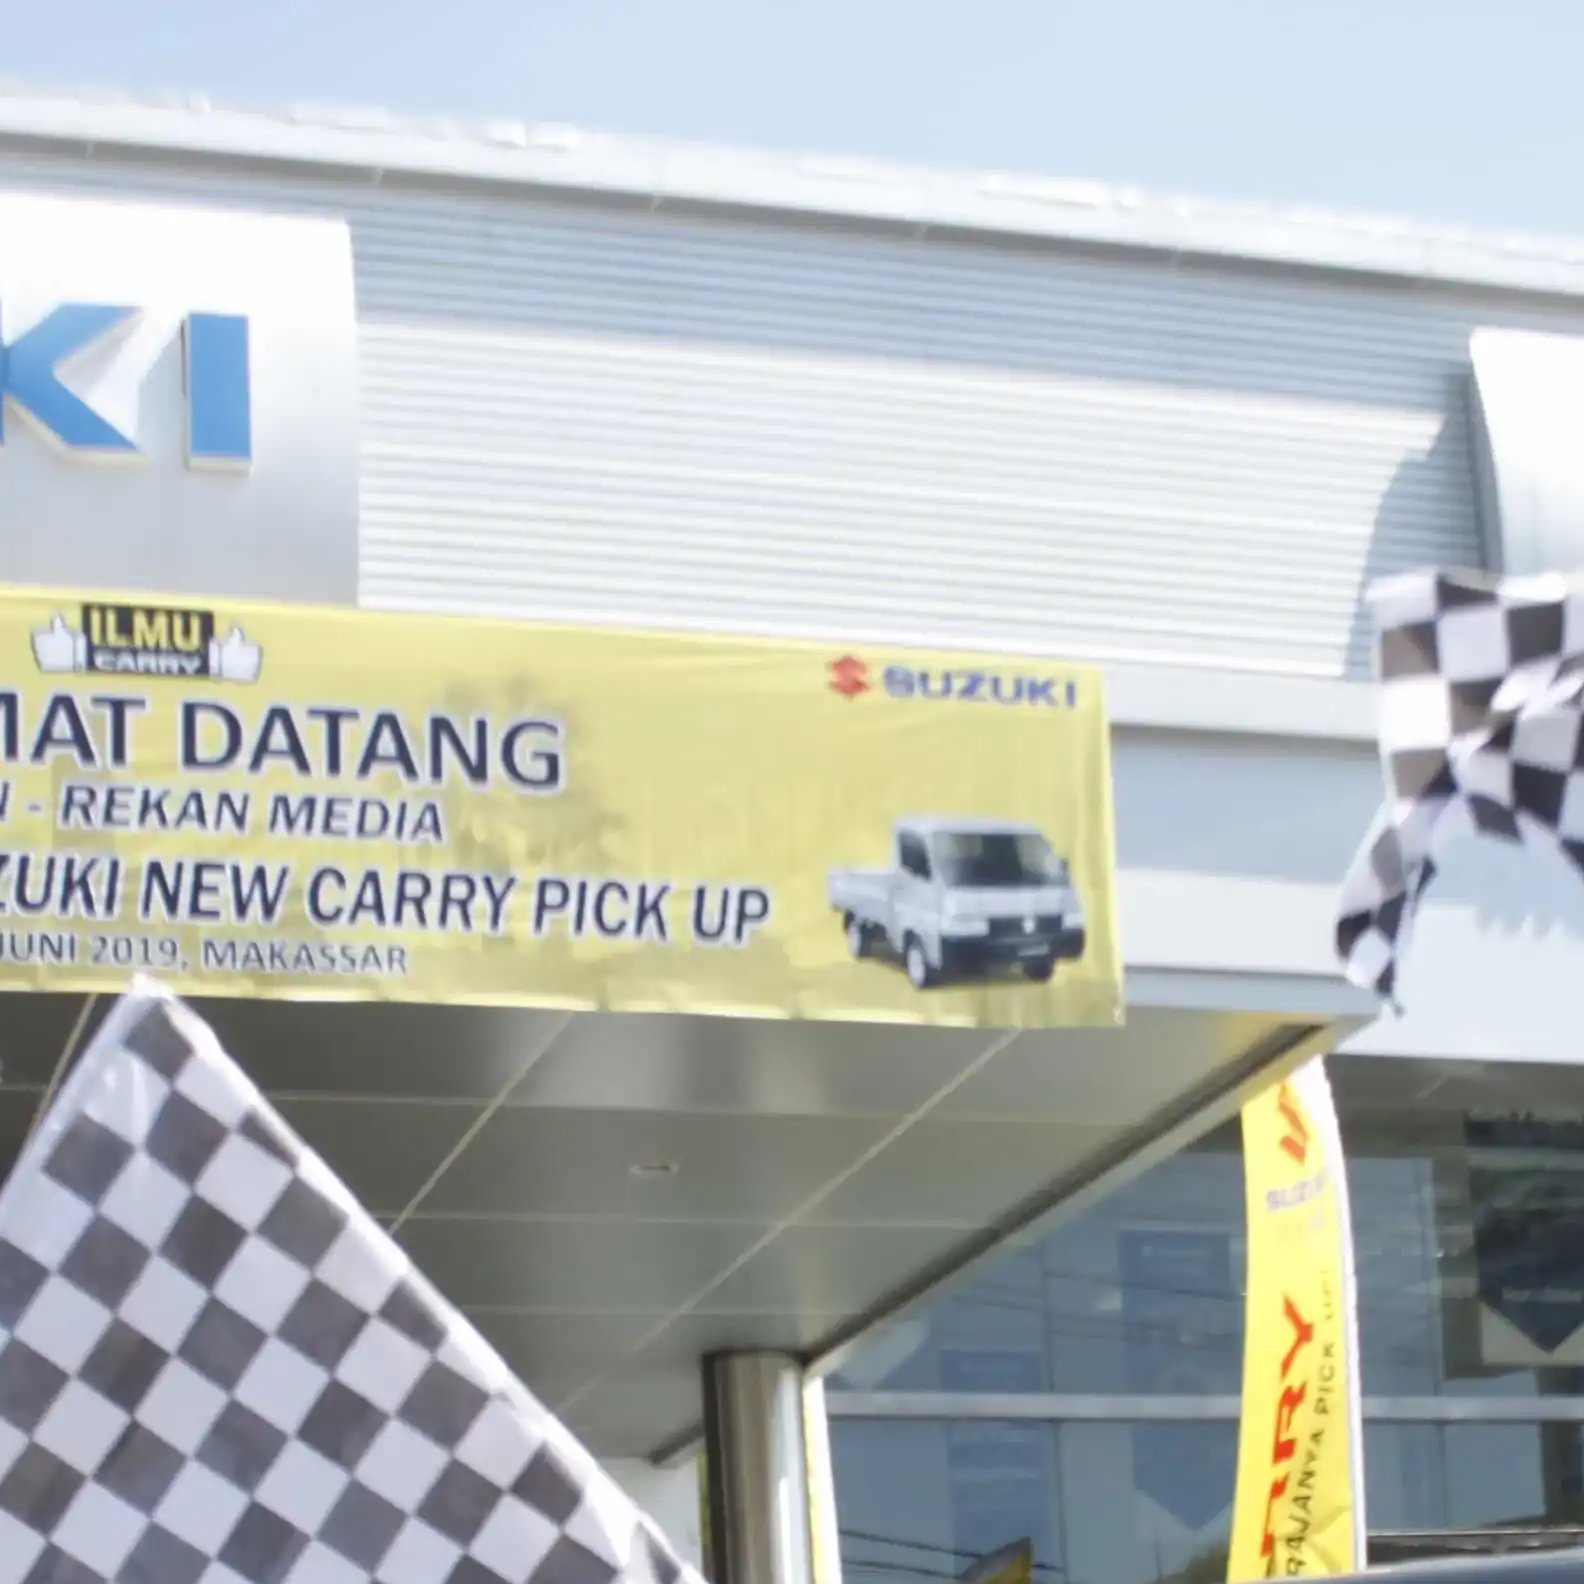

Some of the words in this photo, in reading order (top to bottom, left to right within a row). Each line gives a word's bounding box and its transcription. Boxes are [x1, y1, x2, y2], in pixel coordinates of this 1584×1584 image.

[89, 606, 203, 652] ILMU
[92, 651, 203, 675] CARRY
[882, 666, 1078, 709] SUZUKI
[180, 699, 563, 789] DATANG
[61, 781, 252, 834] REKAN
[269, 794, 445, 843] MEDIA
[141, 860, 290, 923] NEW
[308, 867, 517, 934] CARRY
[533, 877, 671, 940] PICK
[693, 886, 770, 944] UP
[204, 940, 408, 975] MAKASSAR
